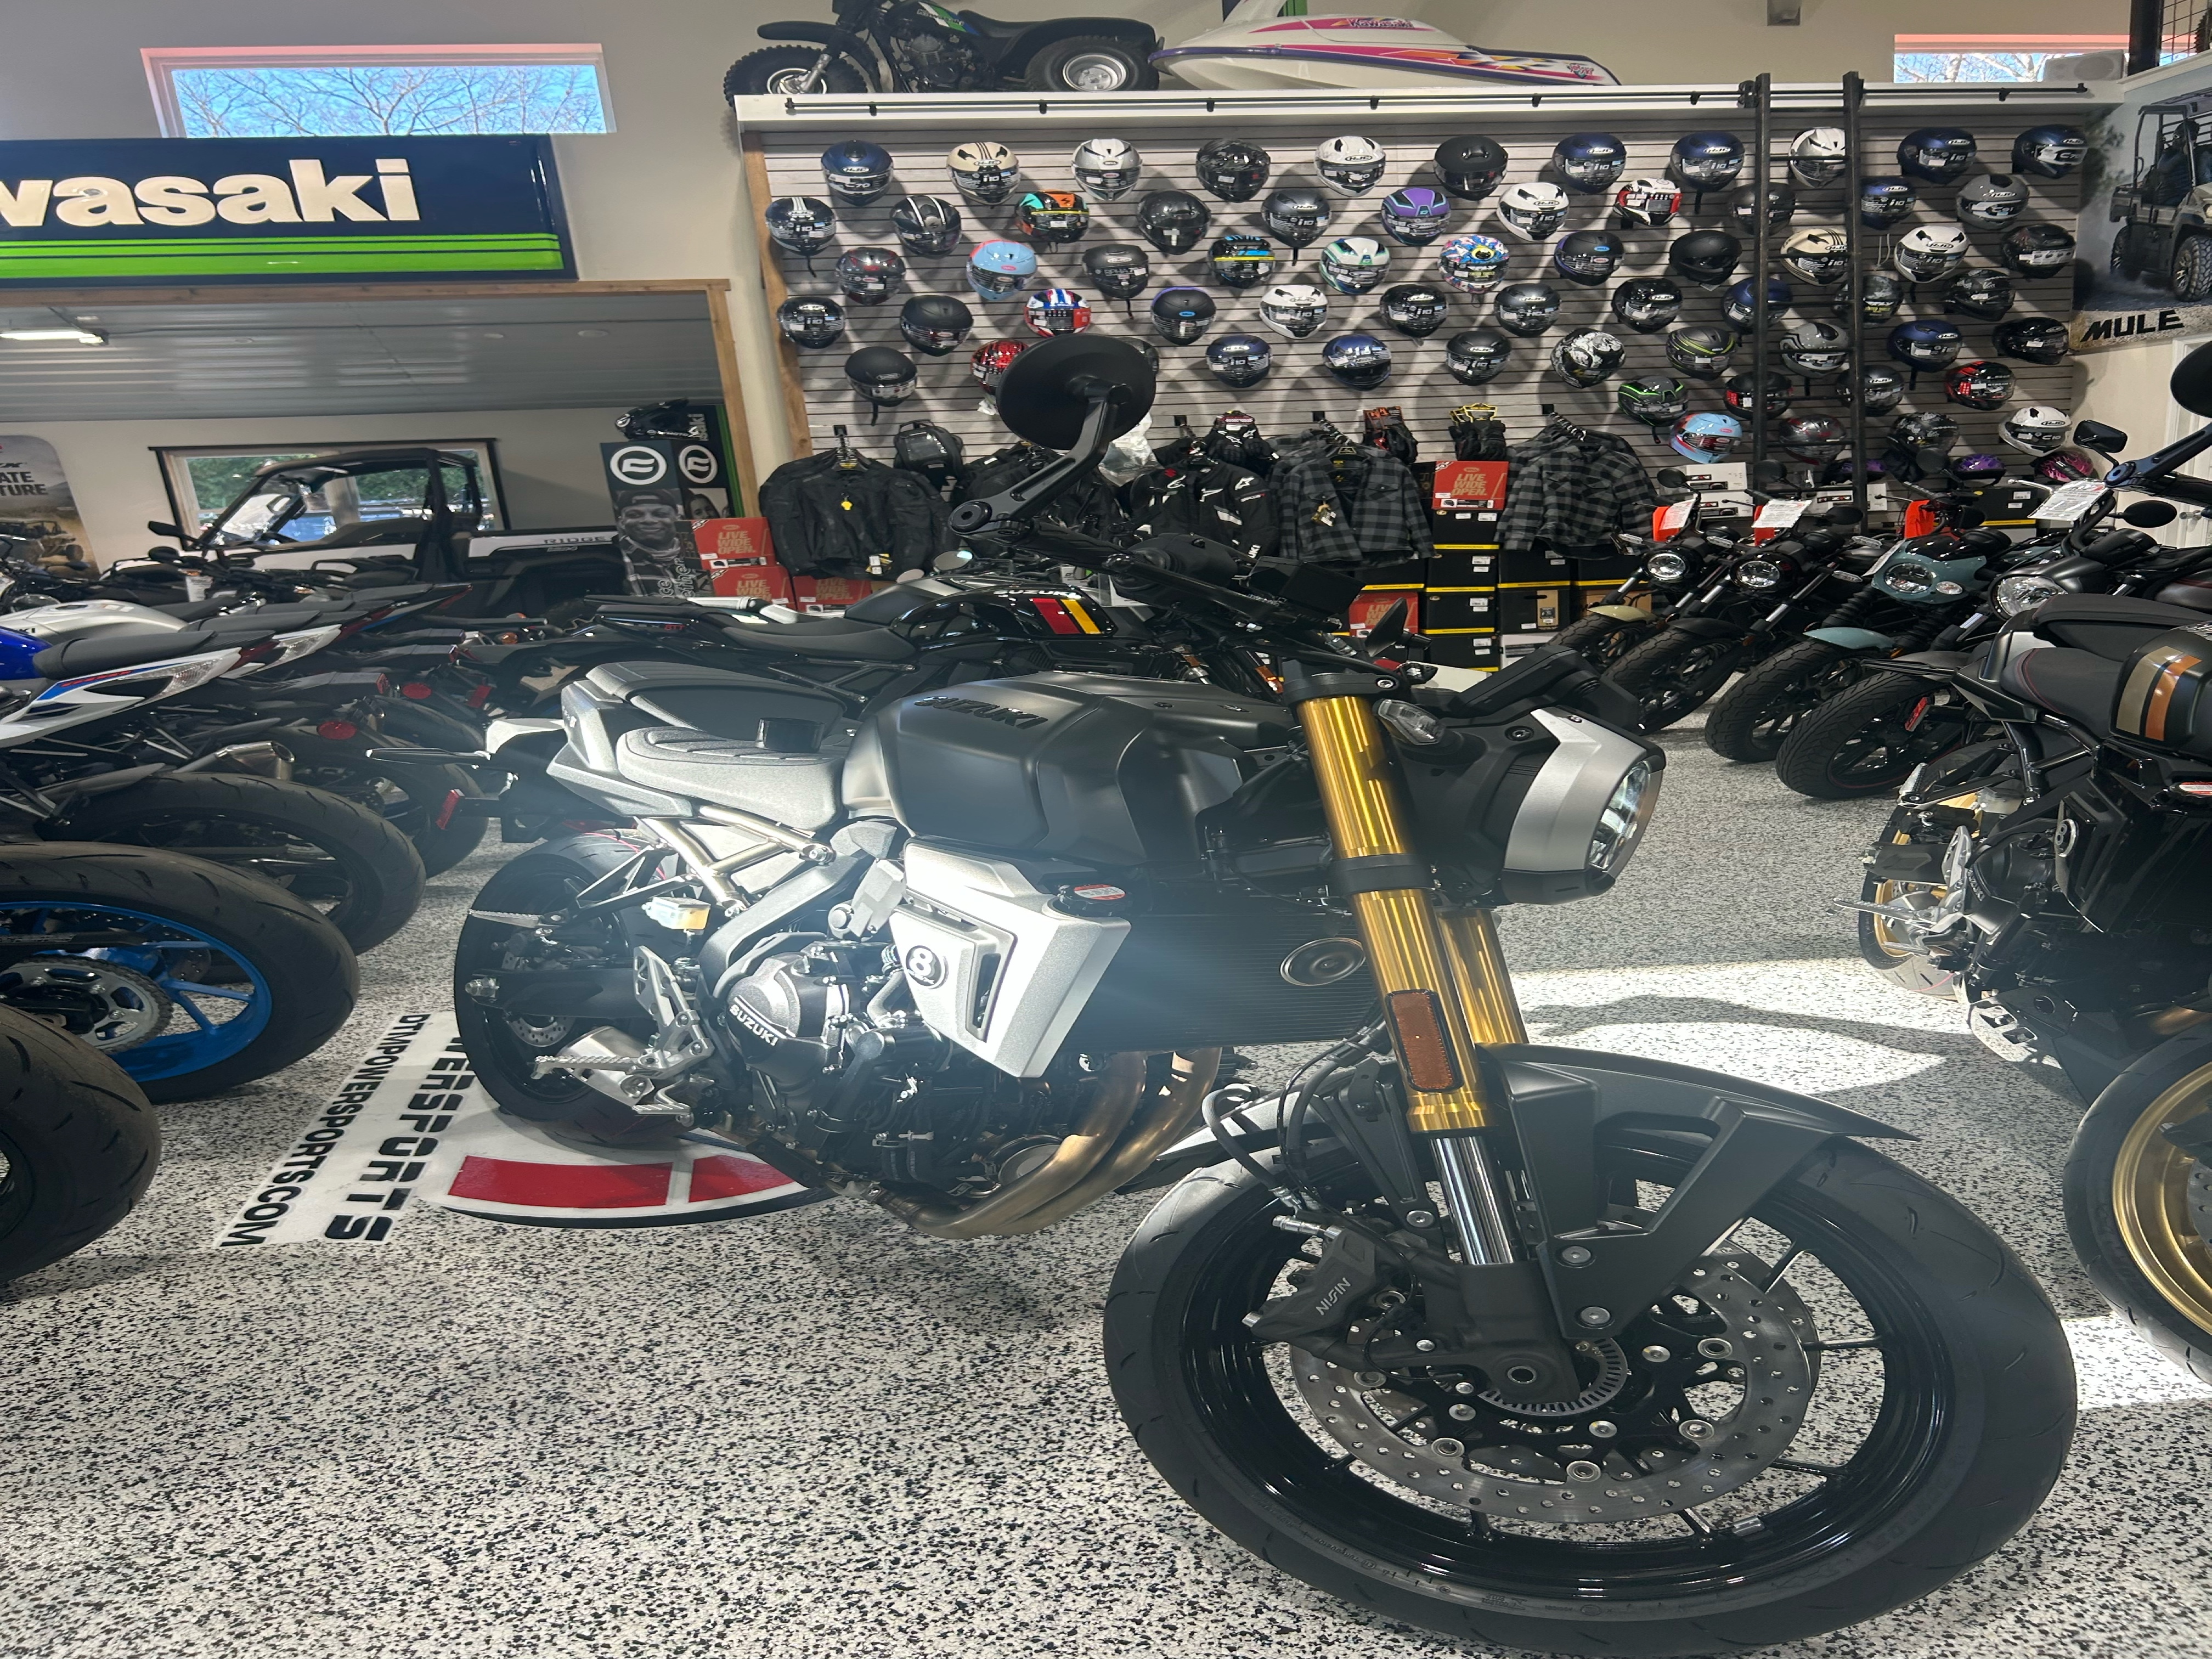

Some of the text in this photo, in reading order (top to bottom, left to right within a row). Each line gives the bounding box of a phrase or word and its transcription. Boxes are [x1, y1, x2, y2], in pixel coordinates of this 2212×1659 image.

[1346, 18, 1416, 28] Kawasaki
[2080, 309, 2185, 342] MULE
[1451, 488, 1487, 496] OPEN.
[544, 536, 606, 544] RIDGE
[719, 531, 748, 539] LIVE
[718, 538, 751, 547] WIDE
[737, 579, 767, 588] LIVE
[736, 587, 770, 596] WIDE
[915, 695, 1048, 730] SUZUKI
[909, 948, 933, 977] 8
[729, 1003, 778, 1047] SUZUKI
[219, 1014, 431, 1248] DTMPOWERSPORTS.COM
[1315, 1277, 1351, 1317] NISSIN
